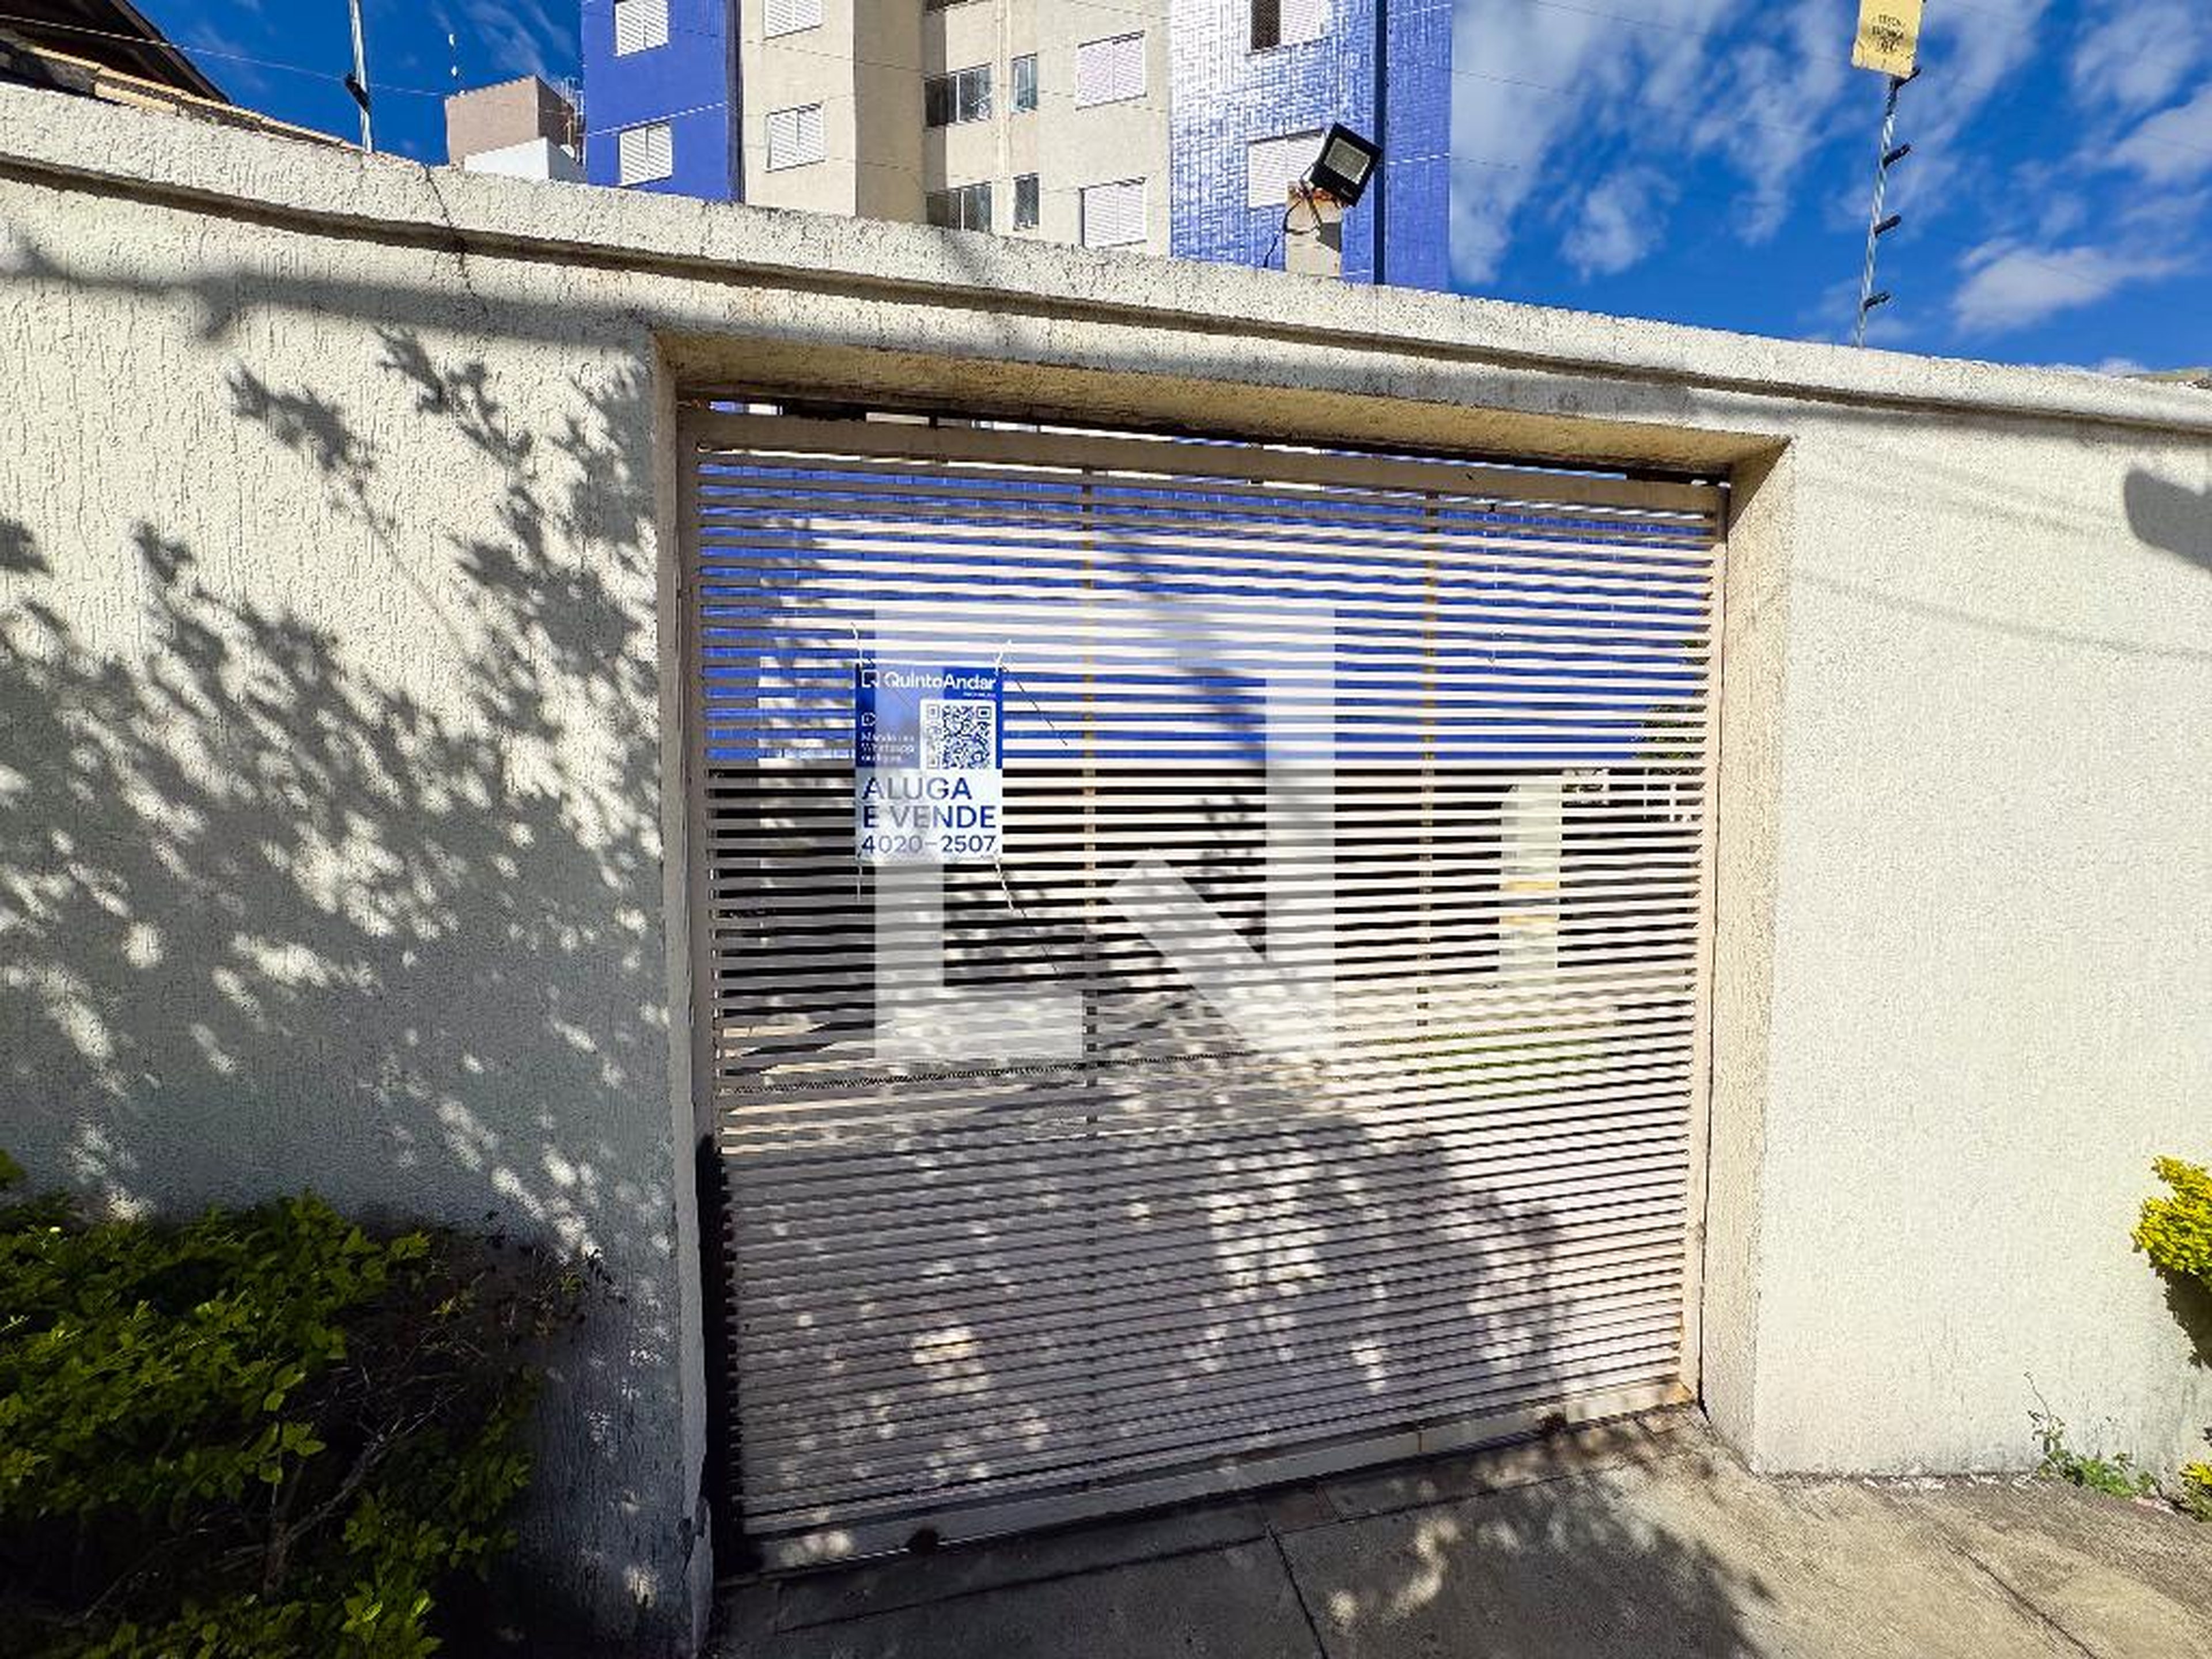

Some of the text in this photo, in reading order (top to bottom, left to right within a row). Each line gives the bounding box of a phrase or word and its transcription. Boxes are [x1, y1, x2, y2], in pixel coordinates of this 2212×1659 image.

[884, 671, 997, 690] QuintoAndar
[861, 777, 973, 800] ALUGA
[863, 805, 997, 828] E VENDE
[861, 835, 997, 854] 4020-2507
